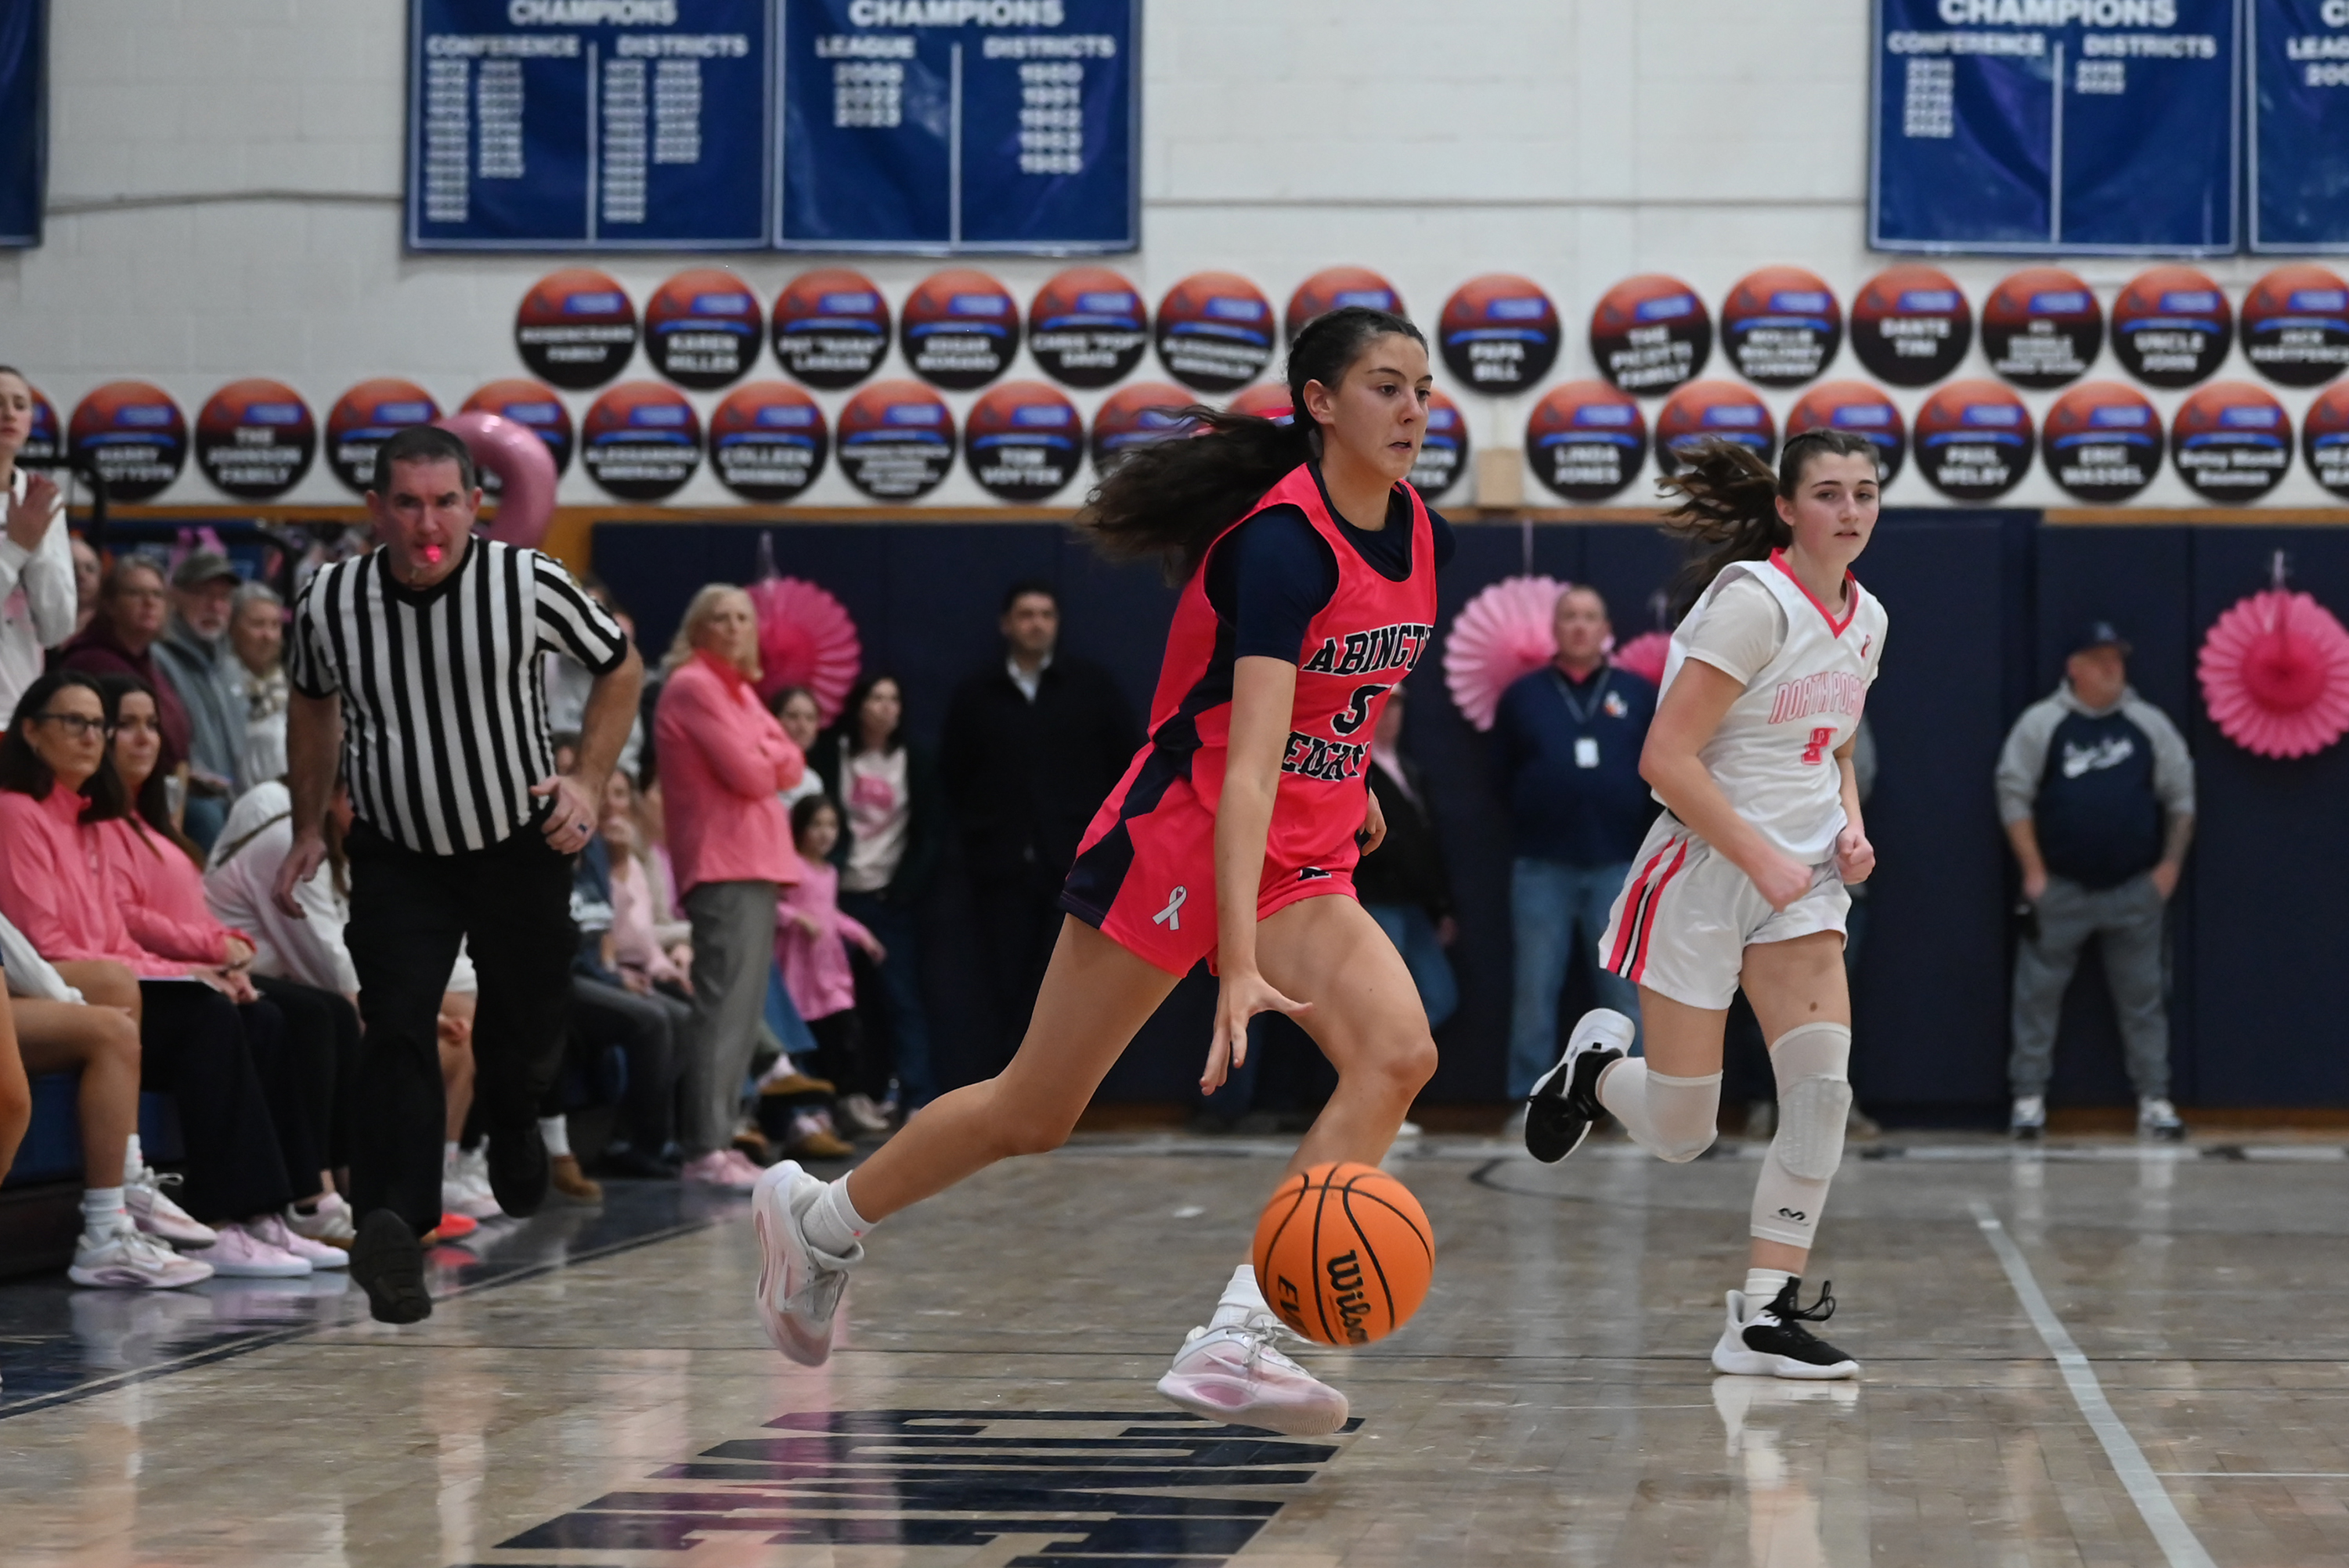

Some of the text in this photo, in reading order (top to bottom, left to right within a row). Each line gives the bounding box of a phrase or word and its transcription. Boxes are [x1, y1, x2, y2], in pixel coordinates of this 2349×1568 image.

[509, 0, 678, 25] CHAMPIONS
[848, 0, 1065, 26] CHAMPIONS
[1937, 0, 2178, 27] CHAMPIONS
[426, 34, 580, 57] CONFERENCE
[616, 34, 749, 57] DISTRICTS
[816, 35, 917, 58] LEAGUE
[983, 35, 1117, 58] DISTRICTS
[1887, 31, 2046, 56] CONFERENCE
[2083, 34, 2216, 59] DISTRICTS
[666, 333, 739, 353] KAREN
[1031, 333, 1088, 352] CHRIS
[1627, 325, 1670, 346] THE
[2134, 332, 2206, 351] UNCLE
[547, 345, 609, 363] FAMILY
[1060, 352, 1117, 369] DAVIS
[1469, 342, 1525, 362] PAPA
[1472, 364, 1521, 382] BILL
[234, 427, 275, 443] THE
[207, 446, 303, 466] JOHNSON
[718, 448, 814, 467] COLLEEN
[999, 447, 1047, 466] TOM
[1553, 445, 1621, 463] LINDA
[1945, 445, 1998, 464] PAUL
[2078, 445, 2127, 464] ERIC
[218, 467, 292, 485] FAMILY
[1553, 465, 1622, 484] JONES
[1768, 670, 1829, 725] NORTH
